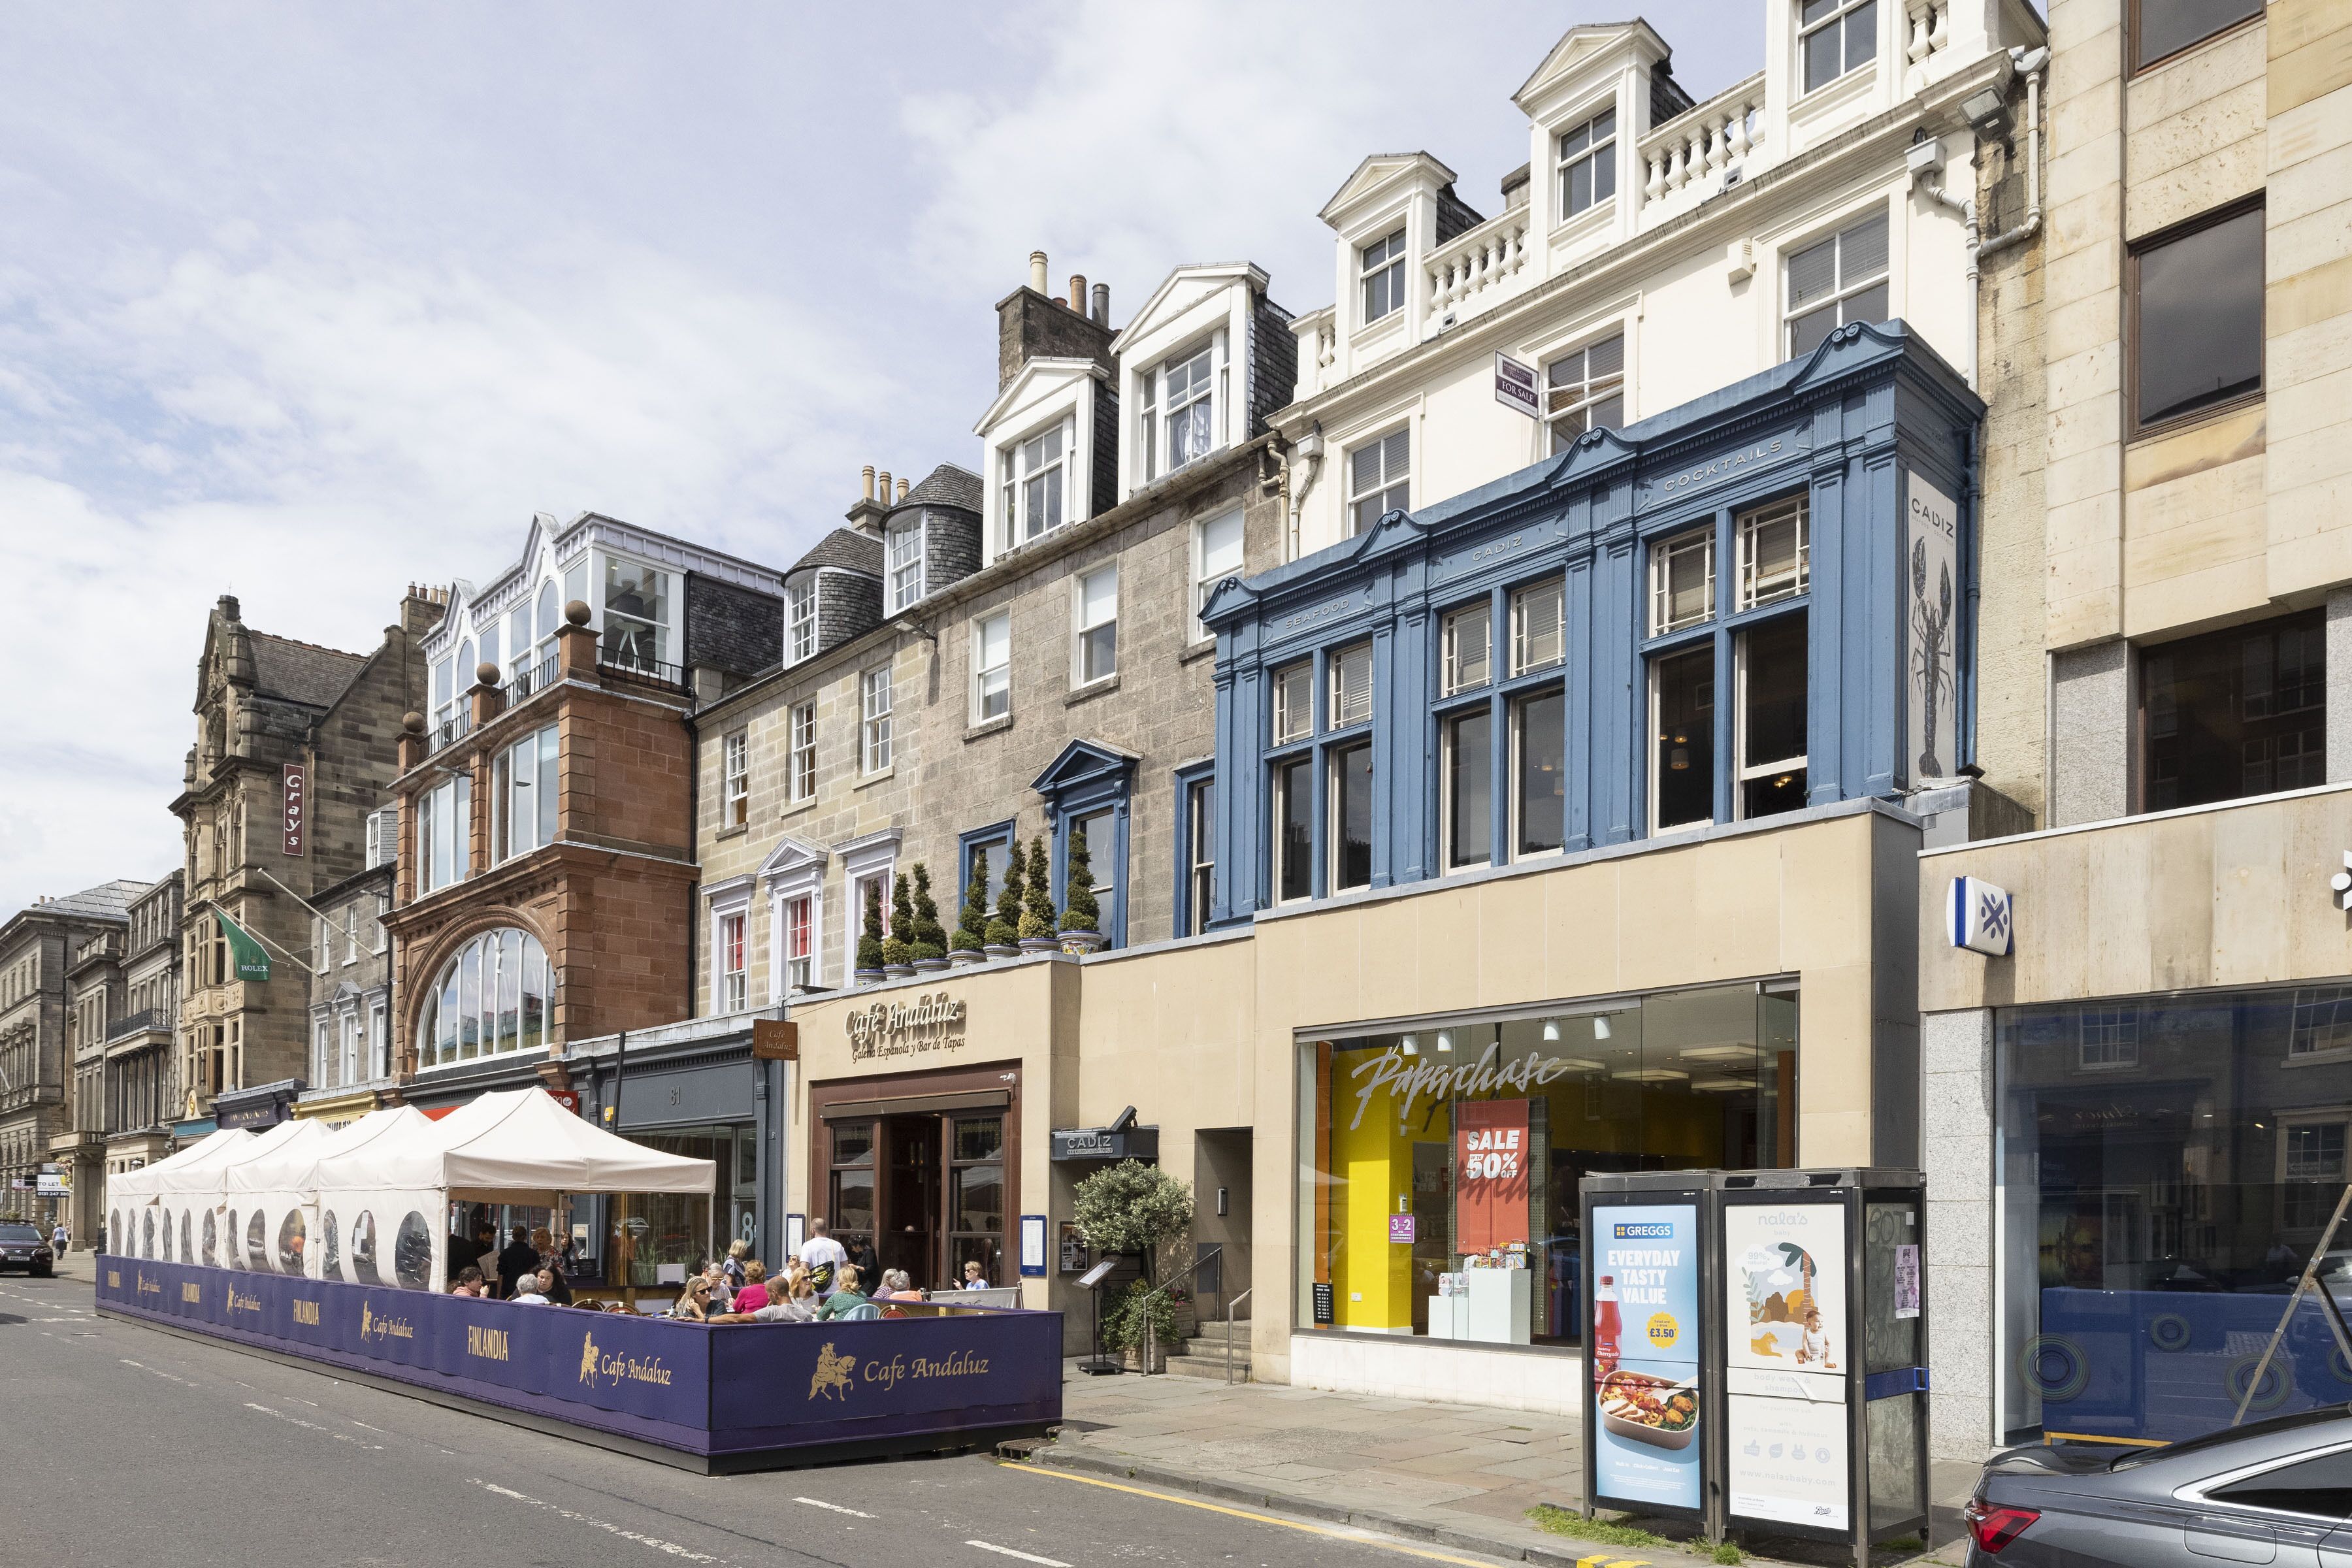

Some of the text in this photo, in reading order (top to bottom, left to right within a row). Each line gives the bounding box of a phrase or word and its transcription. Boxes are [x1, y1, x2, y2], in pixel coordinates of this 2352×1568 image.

[1510, 371, 1525, 382] PROPERTY
[1502, 381, 1516, 395] FOR
[1518, 388, 1533, 403] SALE
[1664, 440, 1782, 491] COCKTAILS
[1912, 497, 1953, 539] CADIZ
[1472, 535, 1523, 562] CADIZ
[1284, 599, 1350, 629] SEAFOOD
[286, 775, 302, 845] Grays
[844, 992, 962, 1044] Café Andaluz
[764, 1041, 792, 1051] Andaluz
[909, 1045, 916, 1058] y
[917, 1041, 930, 1052] Bar
[933, 1037, 941, 1049] de
[943, 1037, 965, 1052] Tapas
[670, 1085, 680, 1105] 81
[1349, 1041, 1569, 1131] Paperchase
[1068, 1135, 1111, 1149] CADIZ
[1467, 1130, 1520, 1151] SALE
[1466, 1152, 1518, 1179] 50% OFF
[1392, 1218, 1399, 1231] 3
[1404, 1218, 1411, 1231] 2
[1758, 1211, 1808, 1226] nala's
[1627, 1226, 1671, 1236] GREGGS
[1608, 1250, 1680, 1267] EVERYDAY
[1621, 1269, 1667, 1286] TASTY
[234, 1293, 261, 1314] Cafe Andaluz
[1622, 1288, 1667, 1304] VALUE
[293, 1299, 319, 1326] FINLANDIA
[373, 1315, 413, 1341] Cafe Andaluz
[468, 1325, 508, 1361] FINLANDIA
[602, 1351, 671, 1386] Cafe Andaluz
[864, 1350, 989, 1391] Cafe Andaluz
[1754, 1373, 1776, 1382] body
[1739, 1470, 1836, 1487] www.nalasbaby.com
[1814, 1505, 1832, 1516] Boots
